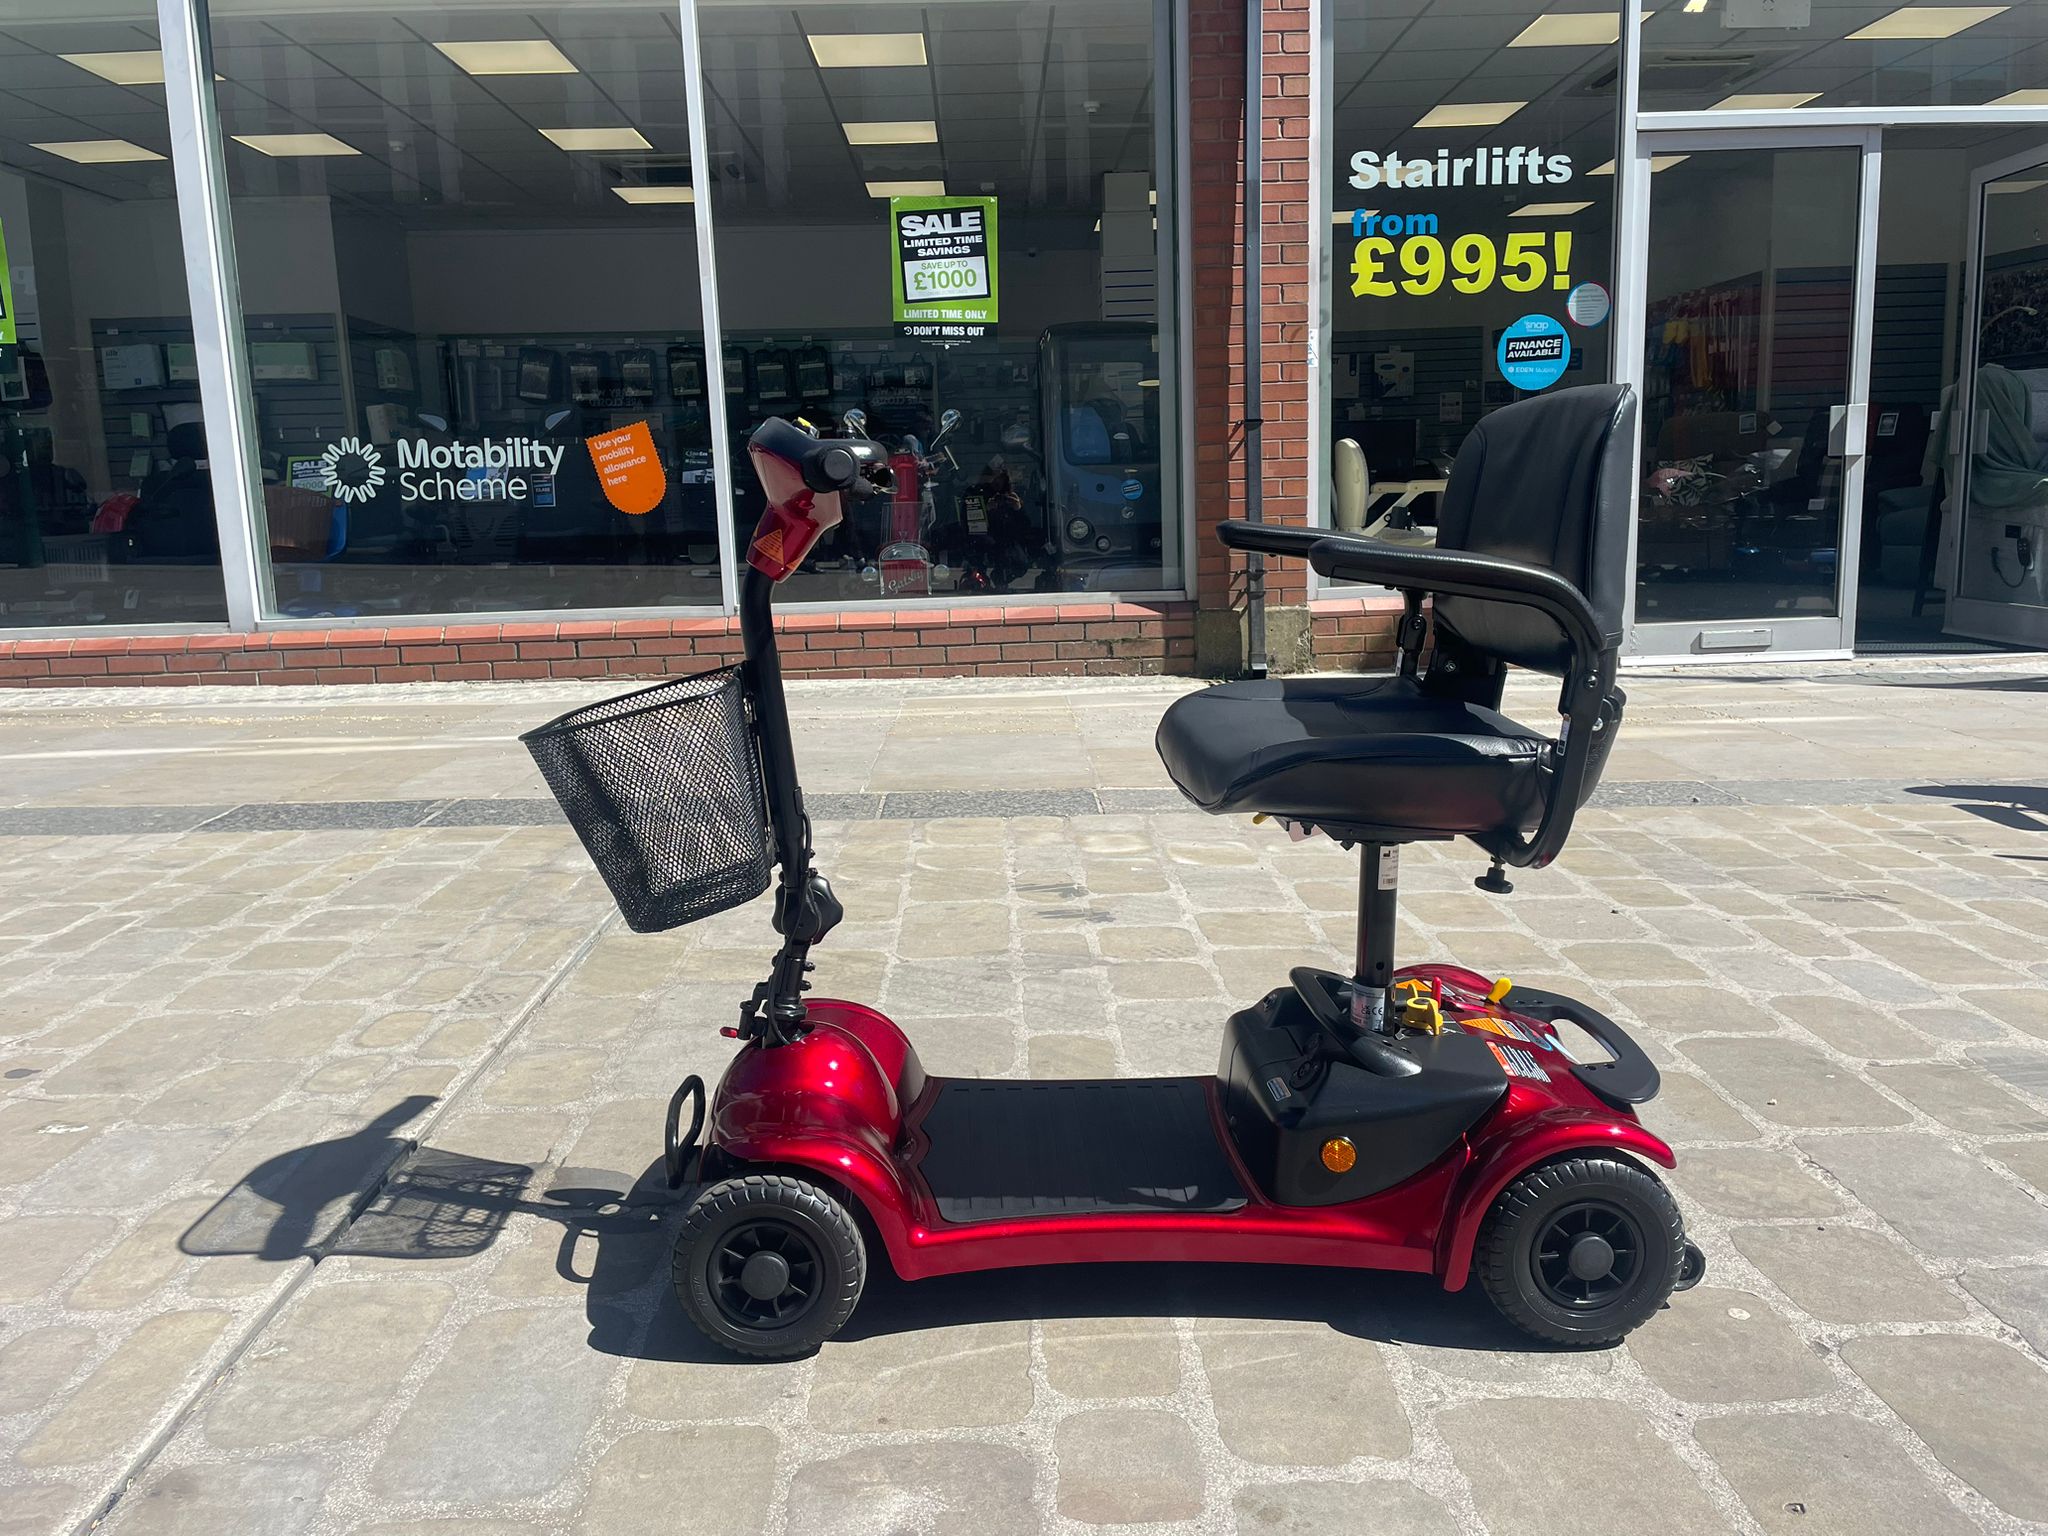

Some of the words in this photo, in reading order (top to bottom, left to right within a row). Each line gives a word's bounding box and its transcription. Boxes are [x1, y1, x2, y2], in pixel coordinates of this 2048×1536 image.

[1348, 146, 1573, 190] Stairlifts
[901, 211, 982, 237] SALE
[1352, 208, 1438, 236] from
[904, 237, 951, 248] LIMITED
[954, 235, 982, 244] TIME
[918, 246, 971, 256] SAVINGS
[921, 262, 942, 270] SAVE
[1350, 231, 1572, 298] £995!
[914, 269, 977, 290] £1000
[904, 309, 939, 319] LIMITED
[941, 309, 962, 319] TIME
[965, 310, 987, 319] ONLY
[913, 326, 940, 335] DON'T
[942, 326, 965, 336] MISS
[967, 327, 984, 336] OUT
[1525, 320, 1549, 331] snap
[1509, 339, 1561, 350] FINANCE
[1507, 348, 1560, 358] AVAILABLE
[594, 440, 611, 450] Use
[612, 433, 631, 446] your
[397, 437, 565, 475] Motability
[599, 446, 634, 462] mobility
[292, 460, 327, 470] SALE
[603, 455, 647, 474] allowance
[400, 472, 528, 501] Scheme
[607, 474, 628, 486] here
